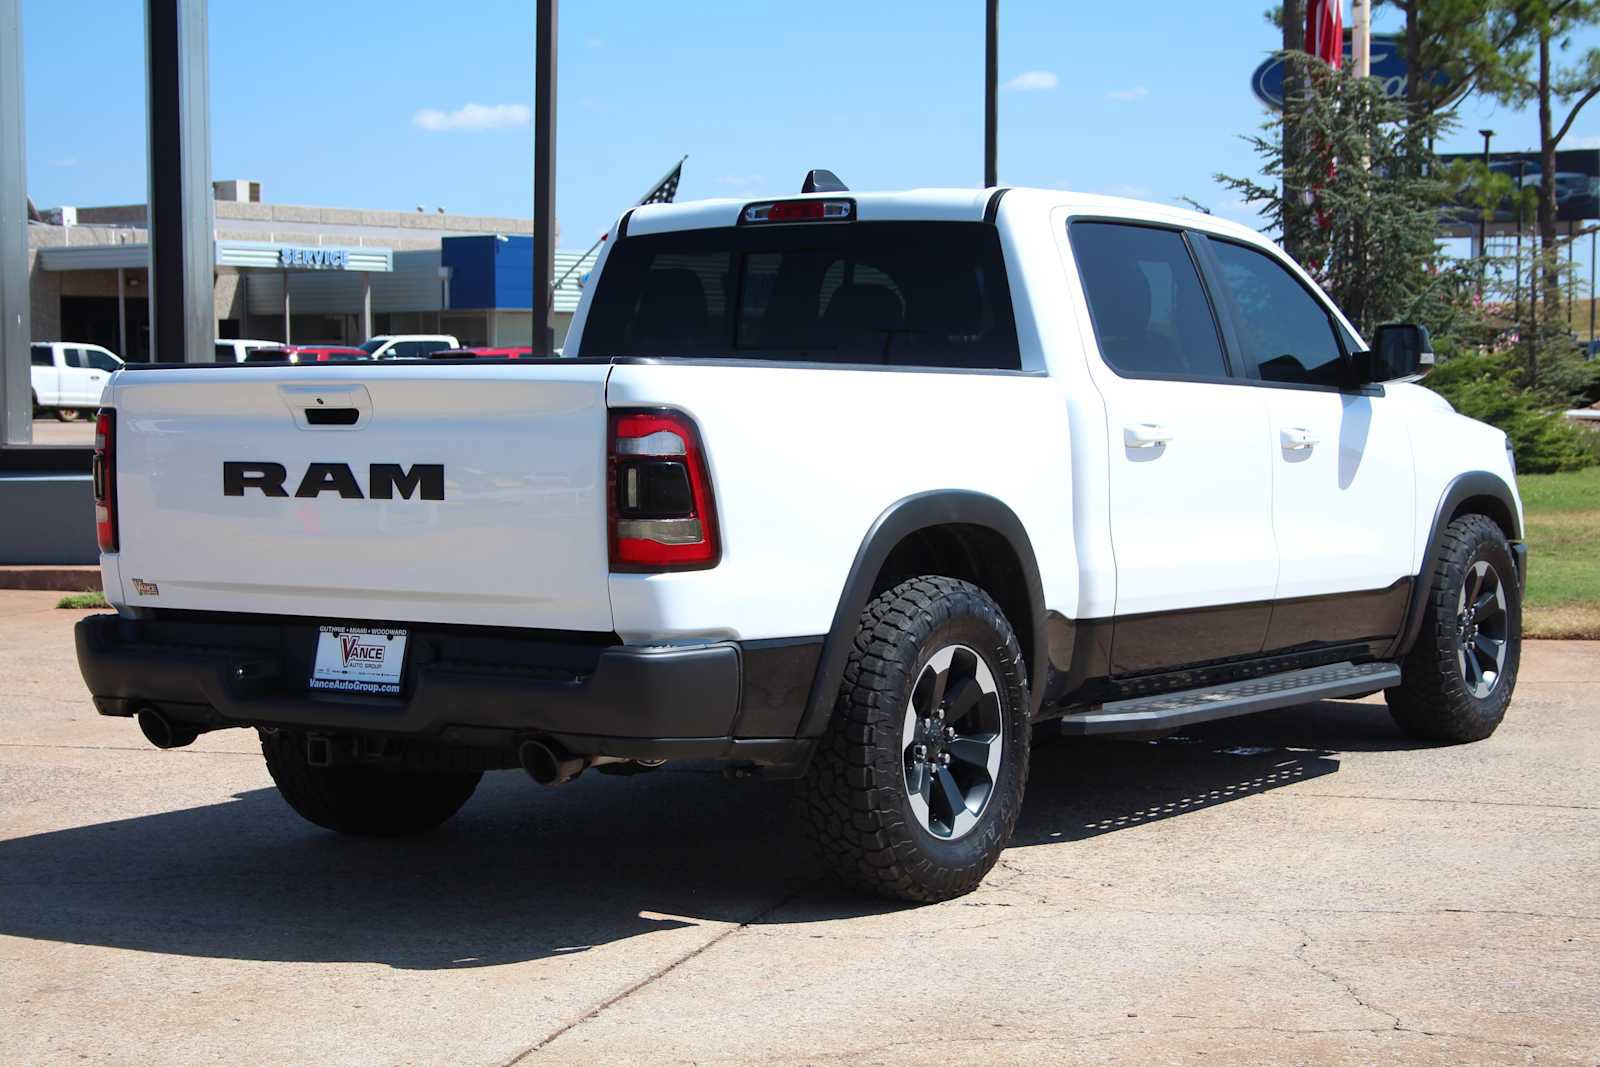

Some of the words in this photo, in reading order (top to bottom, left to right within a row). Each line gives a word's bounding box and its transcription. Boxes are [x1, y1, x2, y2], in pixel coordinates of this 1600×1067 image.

[280, 247, 349, 265] SERVICE
[223, 461, 445, 501] RAM
[340, 635, 383, 668] VANCE
[309, 678, 400, 692] VanceAutoGroup.com
